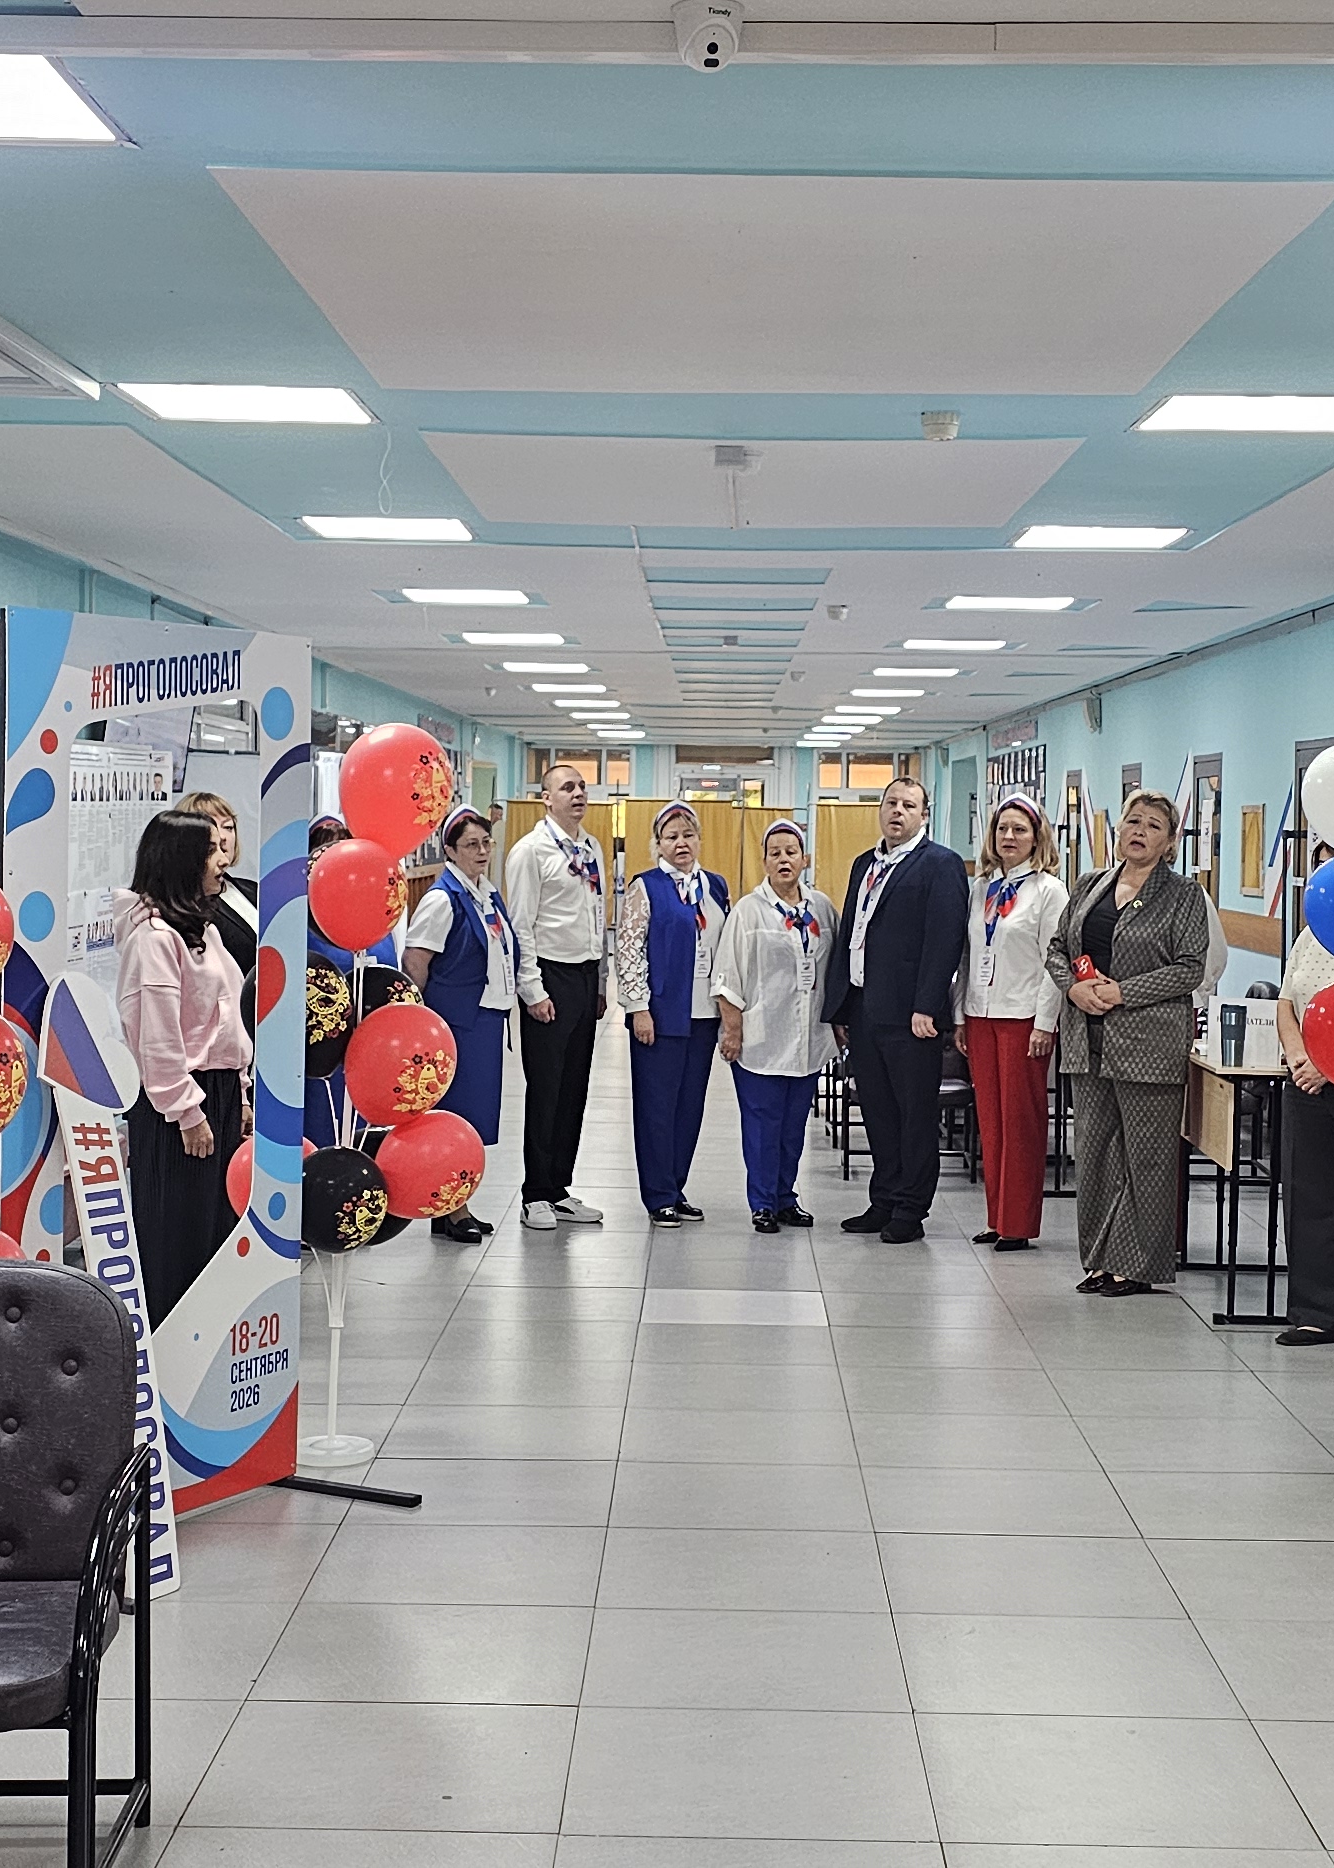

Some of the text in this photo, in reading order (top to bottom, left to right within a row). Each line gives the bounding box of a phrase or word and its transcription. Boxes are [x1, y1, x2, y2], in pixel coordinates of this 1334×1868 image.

[90, 649, 242, 710] #ЯПРОГОЛОСОВАЛ
[230, 1313, 280, 1356] 18-20
[230, 1347, 289, 1386] СЕНТЯБРЯ
[230, 1384, 261, 1413] 2026
